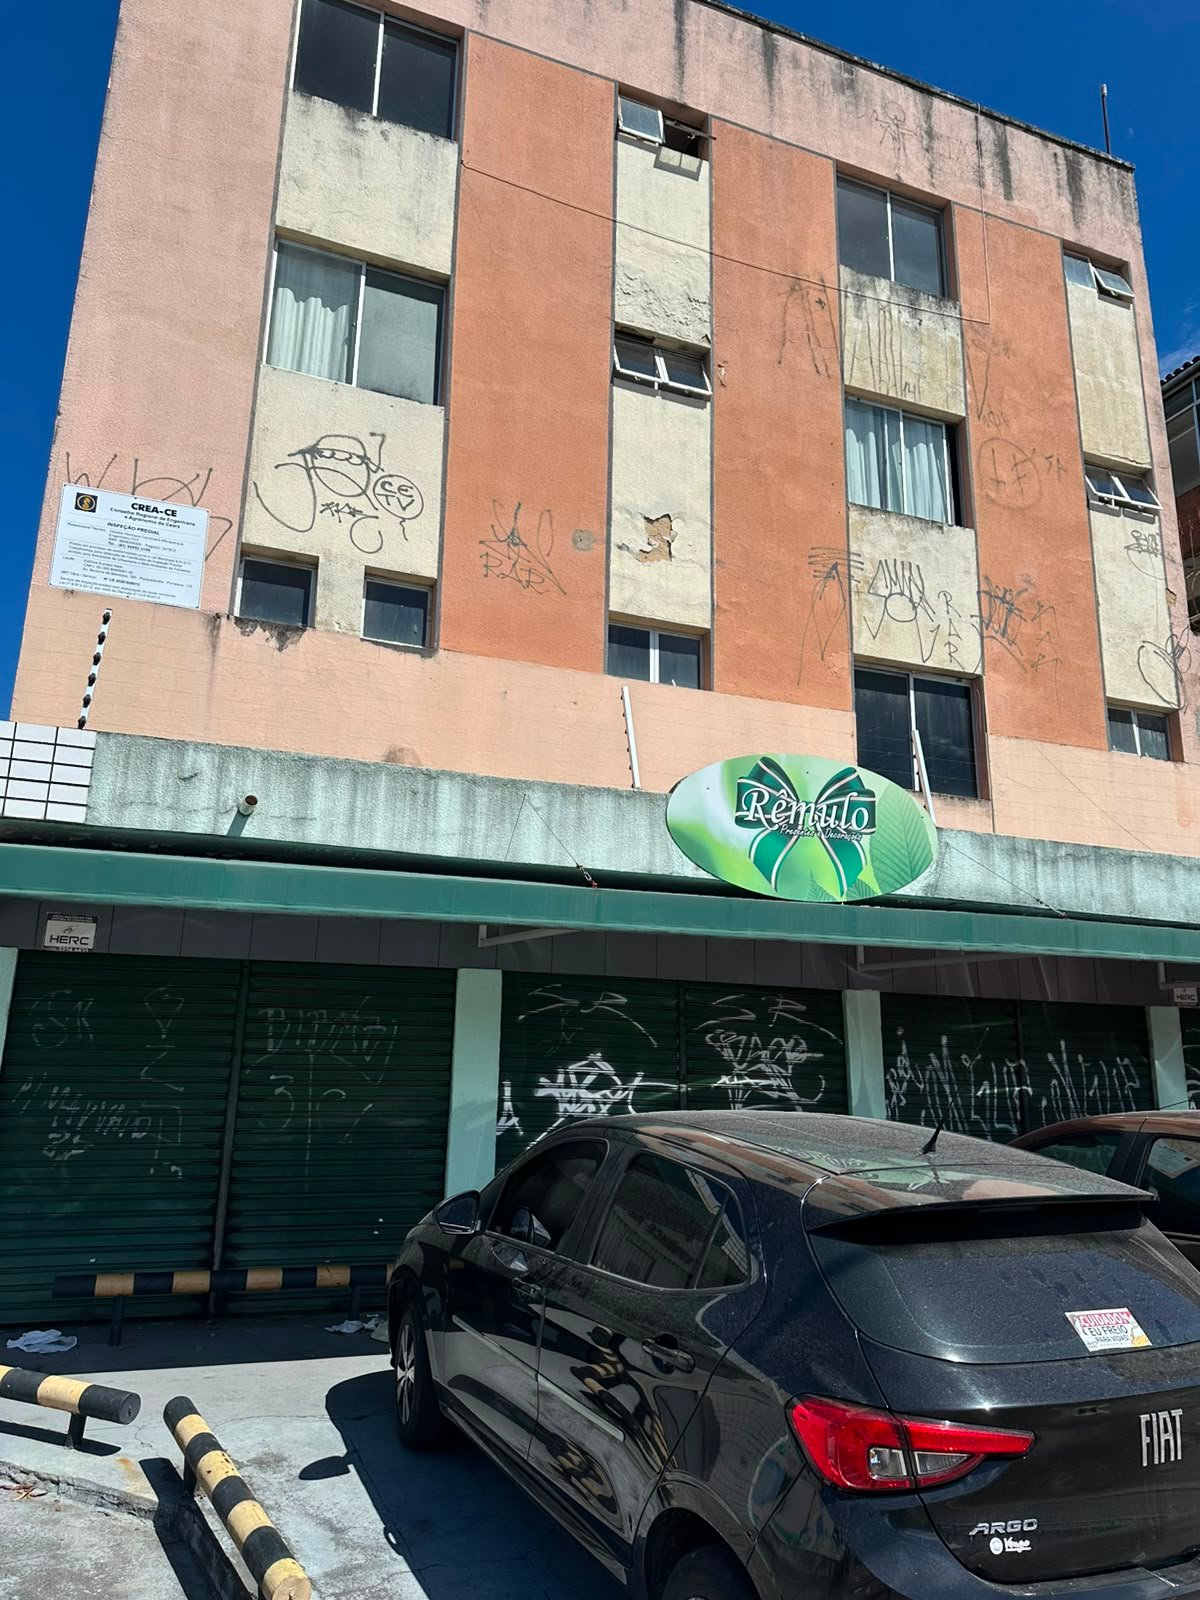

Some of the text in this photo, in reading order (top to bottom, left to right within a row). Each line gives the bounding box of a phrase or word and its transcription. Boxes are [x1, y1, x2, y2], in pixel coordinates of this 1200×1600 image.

[131, 502, 178, 517] CREA-CE
[107, 522, 136, 531] INSPEÇÃO
[137, 527, 160, 535] PREDIAL
[742, 788, 869, 831] Rêmulo
[780, 824, 815, 838] Presentes
[824, 828, 863, 841] Decorações
[50, 934, 89, 946] HERC
[1088, 1325, 1128, 1336] EU FREIO
[1139, 1408, 1183, 1467] FIAT
[969, 1518, 1039, 1535] ARGO
